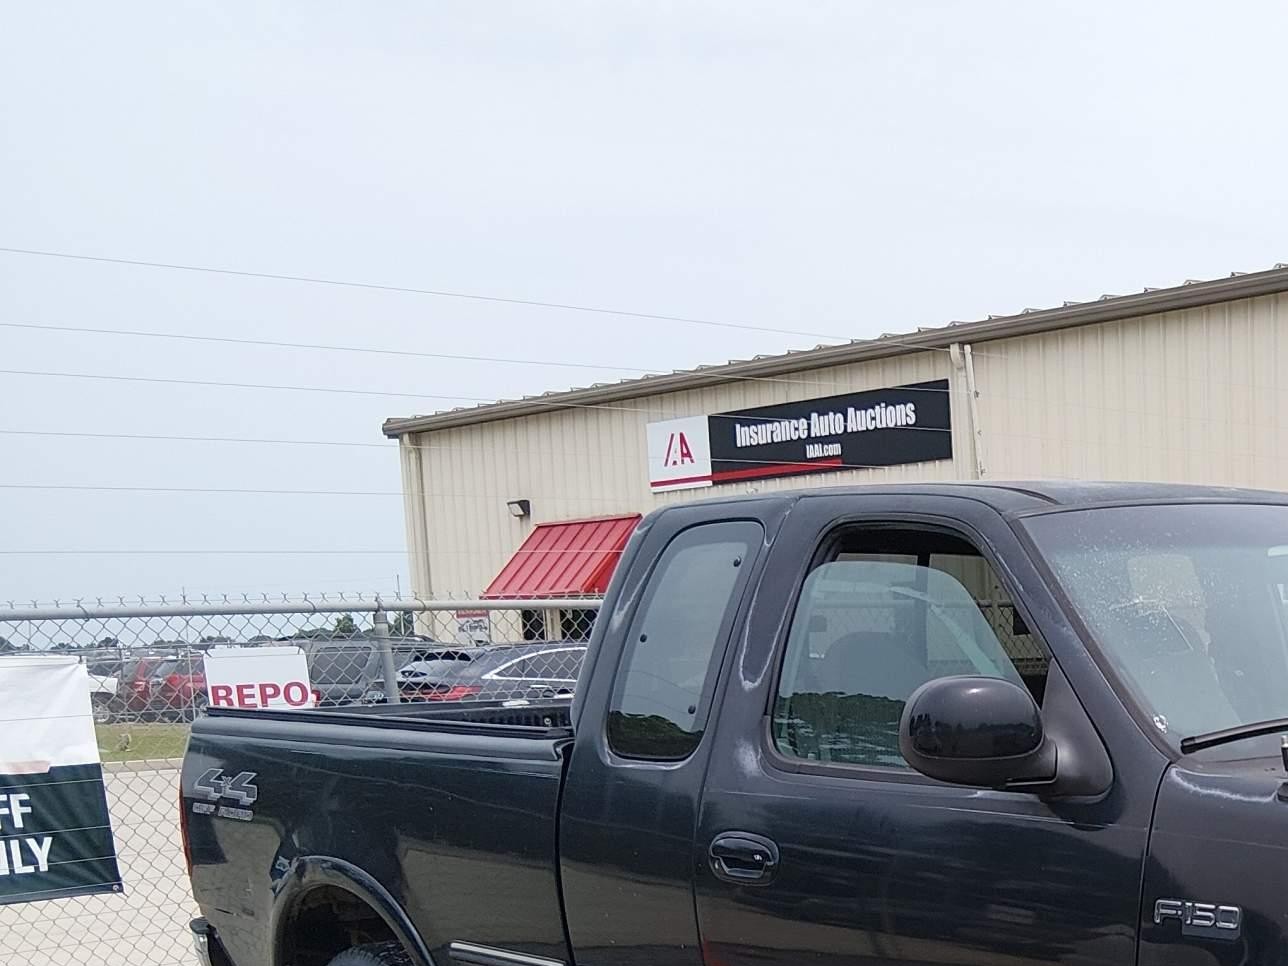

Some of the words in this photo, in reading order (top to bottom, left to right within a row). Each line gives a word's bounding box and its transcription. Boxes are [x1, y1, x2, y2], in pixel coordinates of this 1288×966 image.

[735, 418, 808, 448] Insurance
[810, 412, 845, 438] Auto
[847, 401, 916, 432] Auctions
[211, 681, 309, 708] REPO
